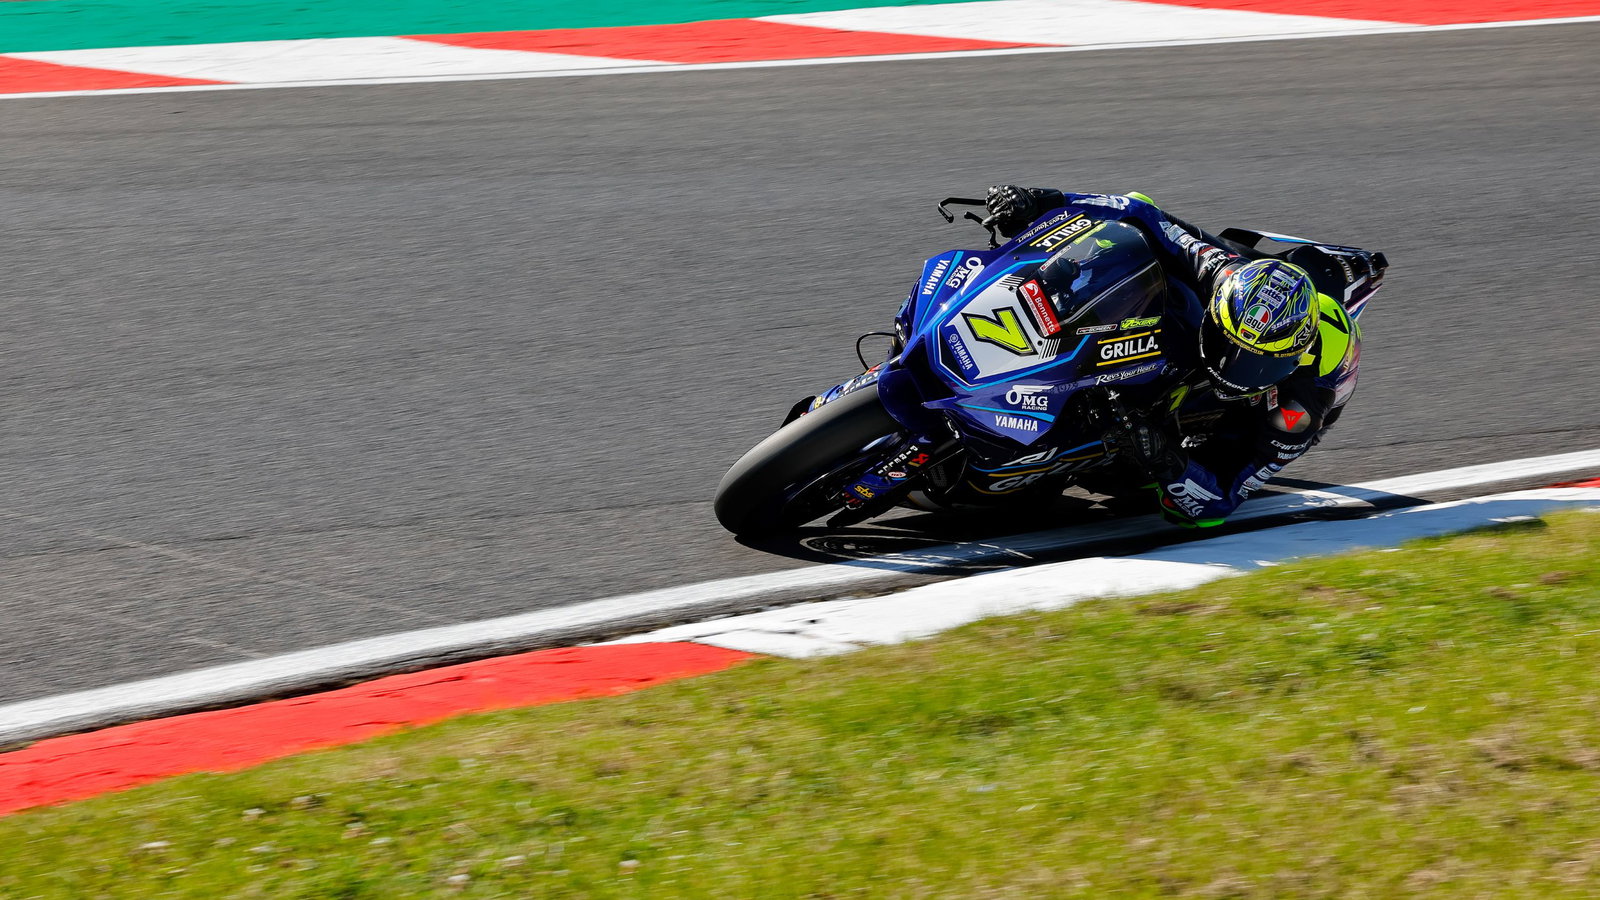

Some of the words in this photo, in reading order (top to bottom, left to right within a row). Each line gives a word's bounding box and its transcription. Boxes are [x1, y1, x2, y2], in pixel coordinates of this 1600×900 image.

[922, 260, 950, 294] YAMAHA
[950, 257, 983, 289] OMG
[1261, 287, 1283, 302] attis
[1034, 295, 1056, 333] Bennetts
[1246, 315, 1264, 332] agv
[963, 307, 1037, 355] 7
[952, 342, 972, 371] YAMAHA
[1006, 387, 1048, 406] OMG
[995, 415, 1038, 432] YAMAHA
[853, 484, 876, 499] sbs
